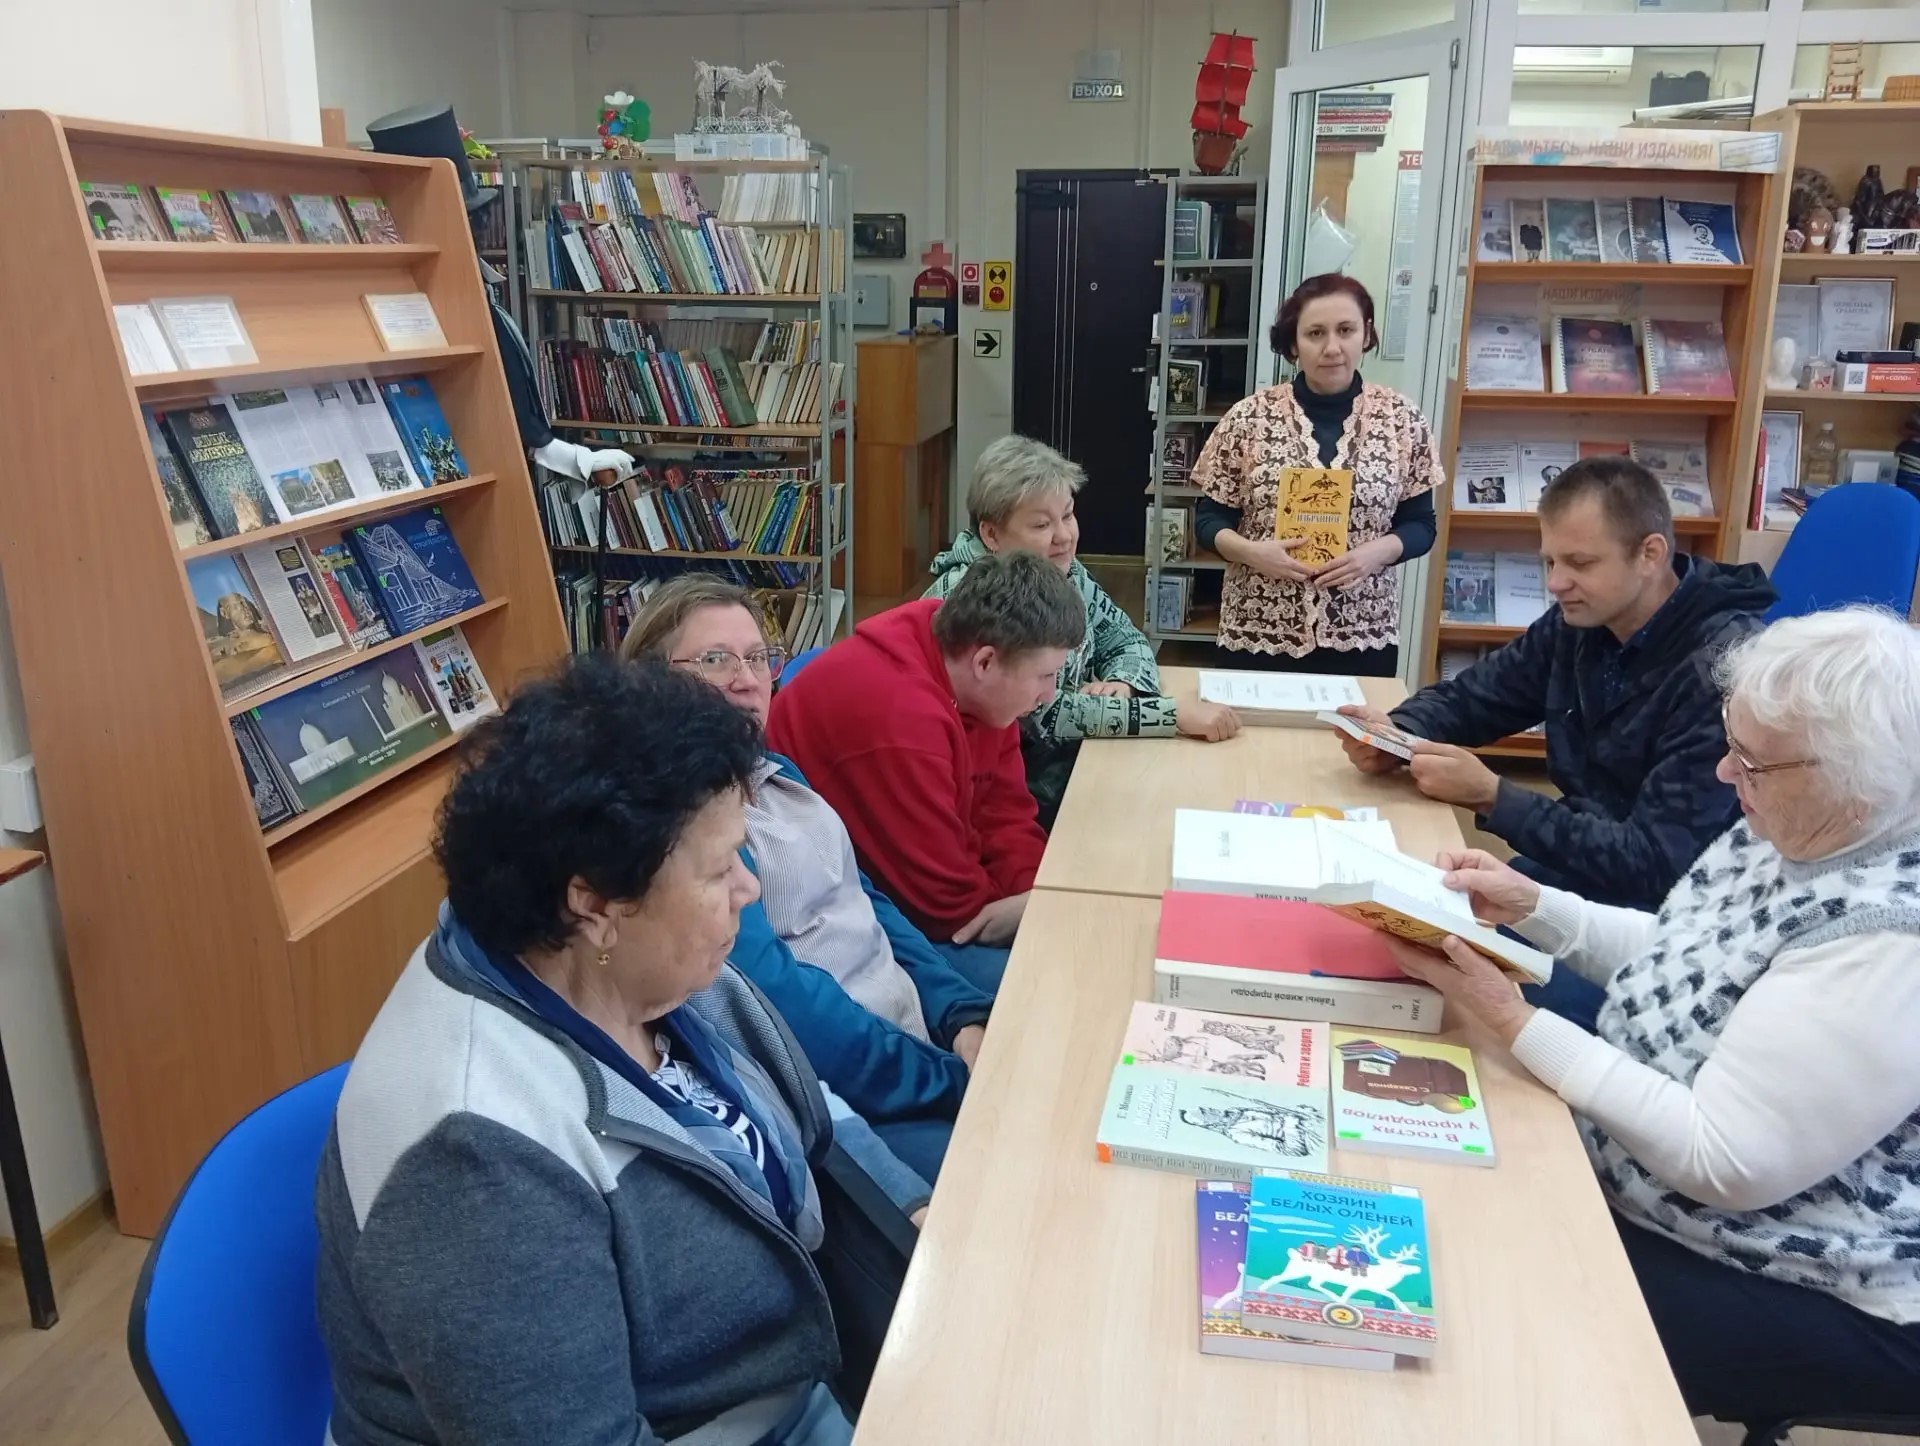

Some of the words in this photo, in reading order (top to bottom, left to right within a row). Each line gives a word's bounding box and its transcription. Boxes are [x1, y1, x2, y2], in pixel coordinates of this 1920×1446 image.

[1075, 84, 1123, 97] ВЫХОД
[1588, 140, 1635, 158] НАШИ
[1637, 141, 1713, 161] ИЗДАНИЯ!
[1162, 708, 1177, 727] CA
[1231, 988, 1273, 999] природы
[1274, 992, 1304, 1001] живой
[1306, 996, 1336, 1007] Тайны
[1300, 1028, 1313, 1056] зверята
[1342, 1108, 1463, 1130] крокодилов
[1372, 1125, 1440, 1140] гостях
[1445, 1134, 1459, 1143] В
[1301, 1190, 1377, 1210] ХОЗЯИН
[1271, 1198, 1333, 1215] БЕЛЫХ
[1338, 1208, 1414, 1227] ОЛЕНЕЙ
[1339, 1311, 1347, 1320] 2
